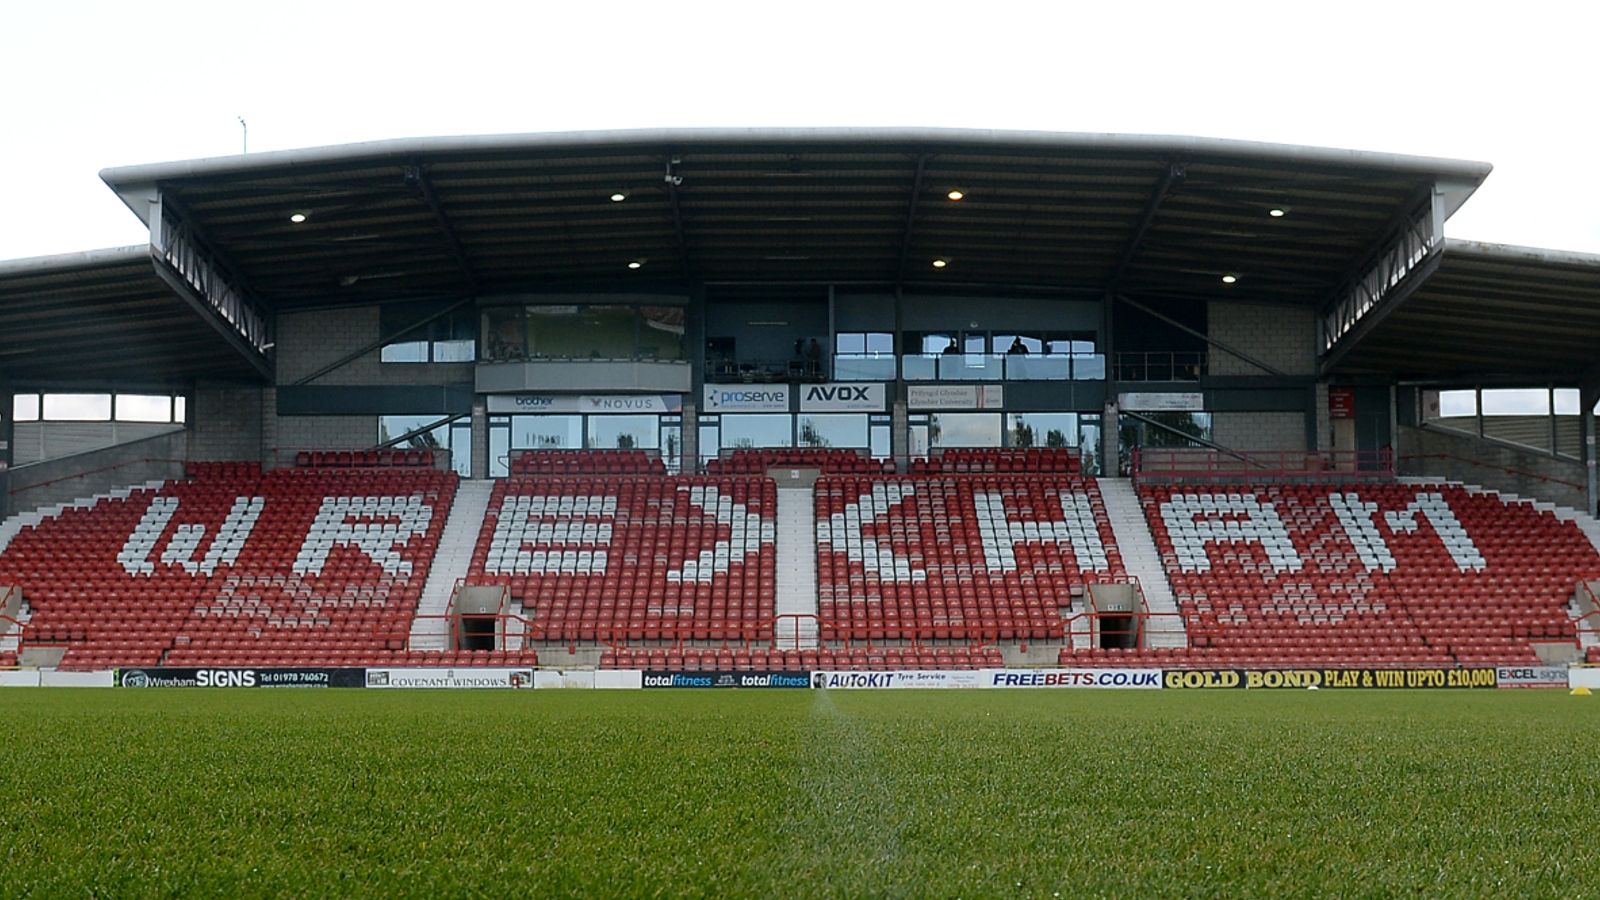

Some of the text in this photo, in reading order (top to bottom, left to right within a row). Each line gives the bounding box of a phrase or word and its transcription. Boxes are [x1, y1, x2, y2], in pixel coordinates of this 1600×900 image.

[721, 391, 785, 404] proserve
[806, 386, 870, 401] AVOX
[603, 399, 653, 409] NOVUS
[150, 676, 196, 688] Wrexham
[196, 670, 256, 688] SIGNS
[260, 673, 272, 682] Tel
[273, 672, 298, 682] 01978
[898, 672, 946, 681] Tyre Service
[993, 672, 1159, 686] FREEBETS.CO.UK
[1165, 671, 1240, 689] GOLD
[1248, 671, 1322, 688] BOND
[1324, 670, 1360, 688] PLAY
[1362, 671, 1373, 687] &
[1375, 670, 1405, 687] WIN
[1447, 669, 1494, 688] £10,000
[1498, 669, 1568, 682] EXCEL signs
[391, 678, 507, 687] COVENANT WINDOWS
